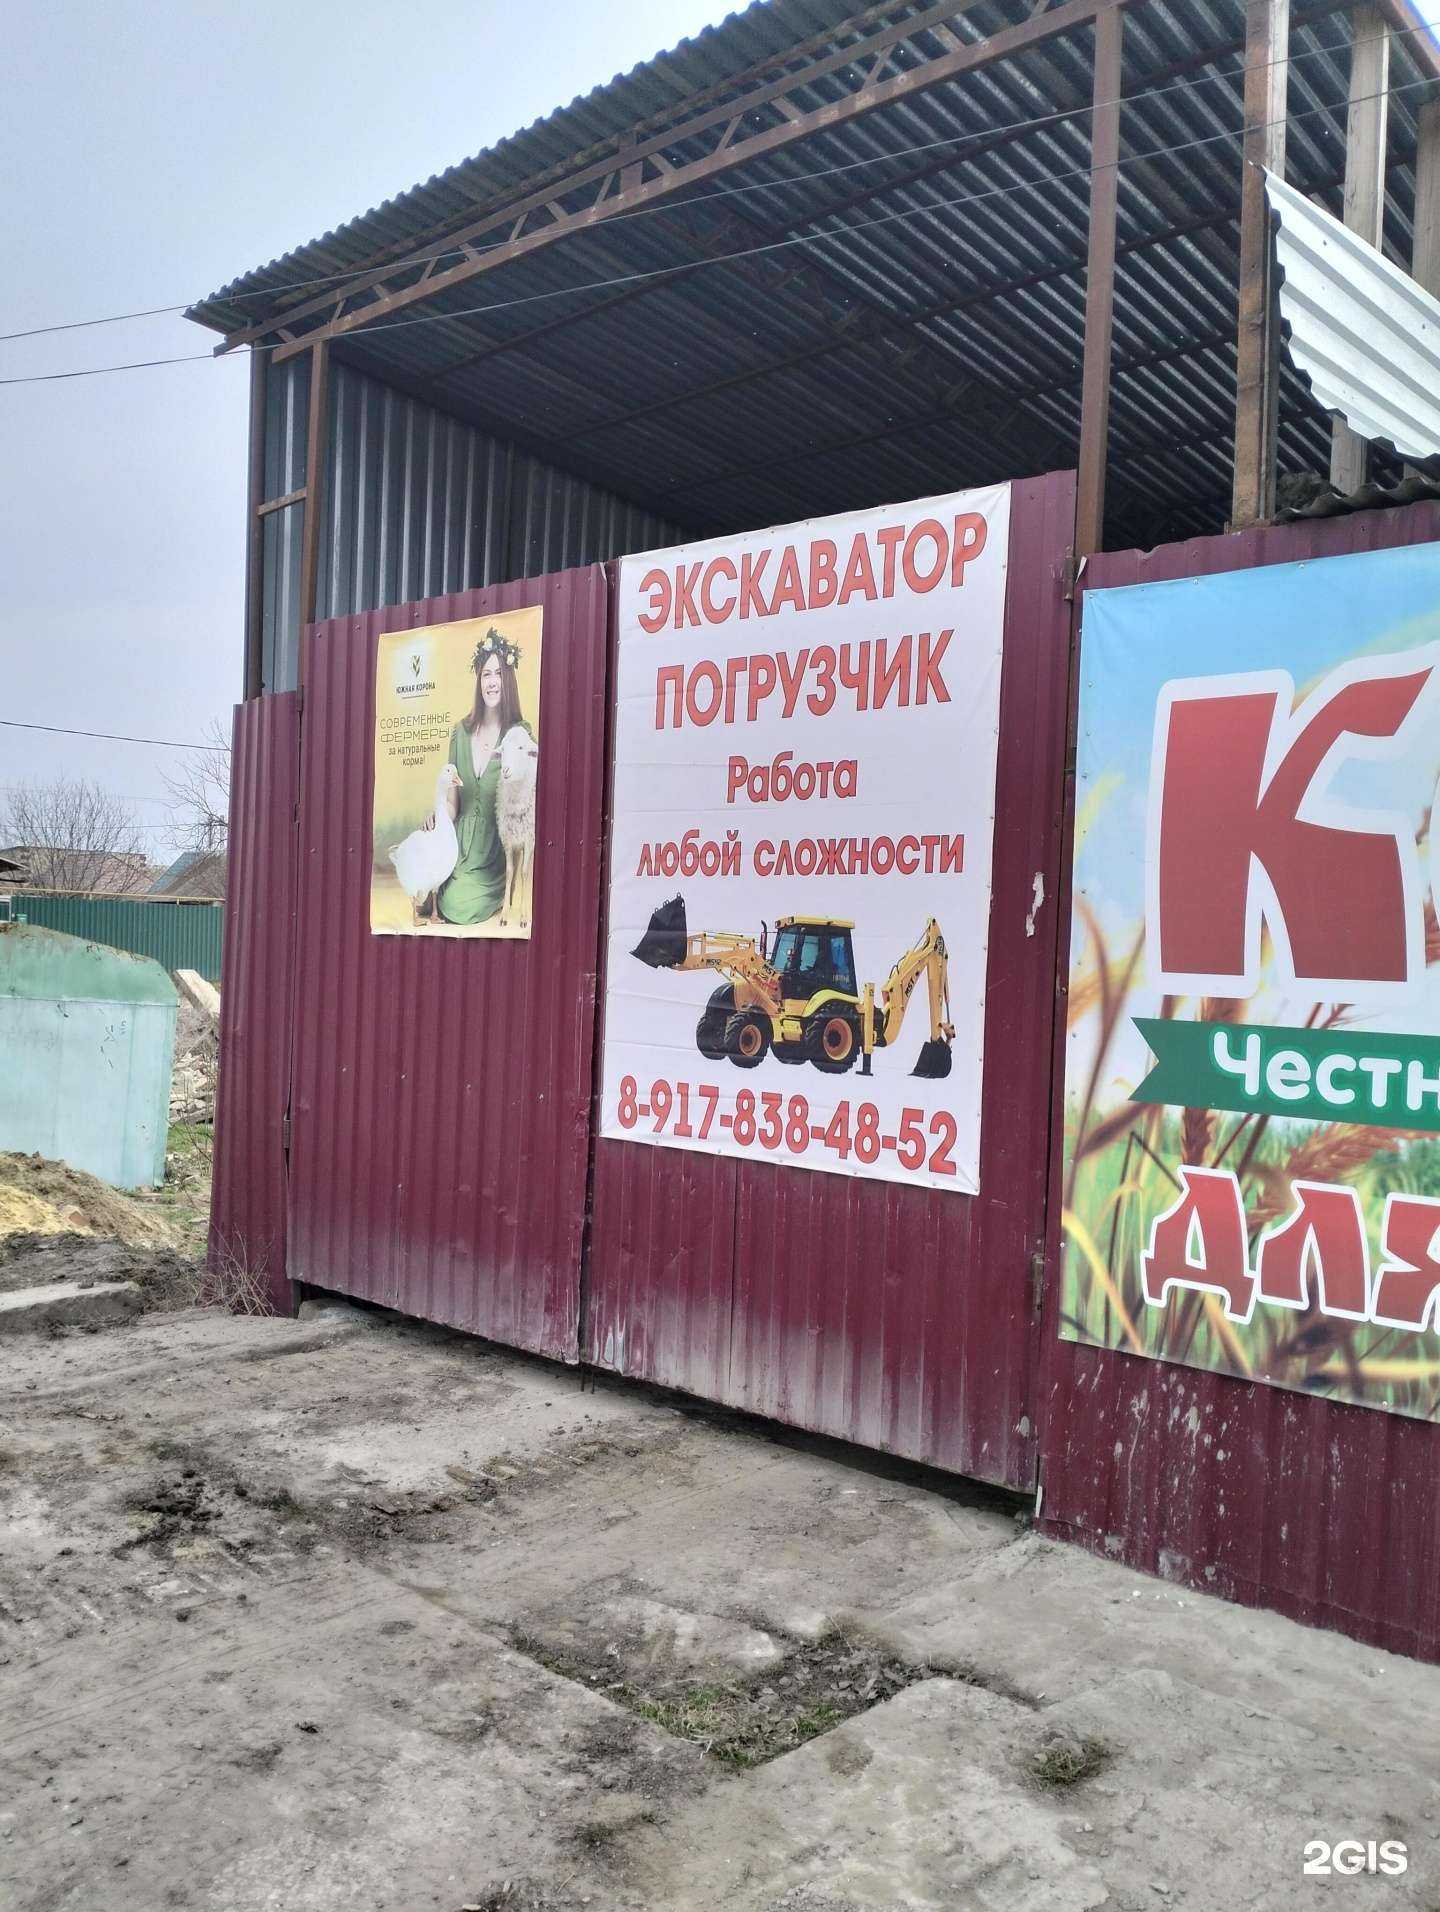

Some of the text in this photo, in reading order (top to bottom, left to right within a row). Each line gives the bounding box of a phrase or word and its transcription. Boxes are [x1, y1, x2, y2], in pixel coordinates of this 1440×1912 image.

[637, 511, 989, 634] ЭКСКАВАТОР
[396, 681, 436, 695] ЮЖНАЯ КОРОНА
[655, 628, 955, 730] ПОГРУЗЧИК
[379, 711, 451, 729] СОВРЕМЕННЫЕ
[380, 727, 450, 743] ФЕРМЕРЫ
[388, 743, 441, 757] за натуральные
[726, 750, 858, 804] Работа
[1158, 664, 1438, 984] К
[636, 829, 965, 878] любой сложности
[617, 1074, 958, 1176] 8-917-838-48-52
